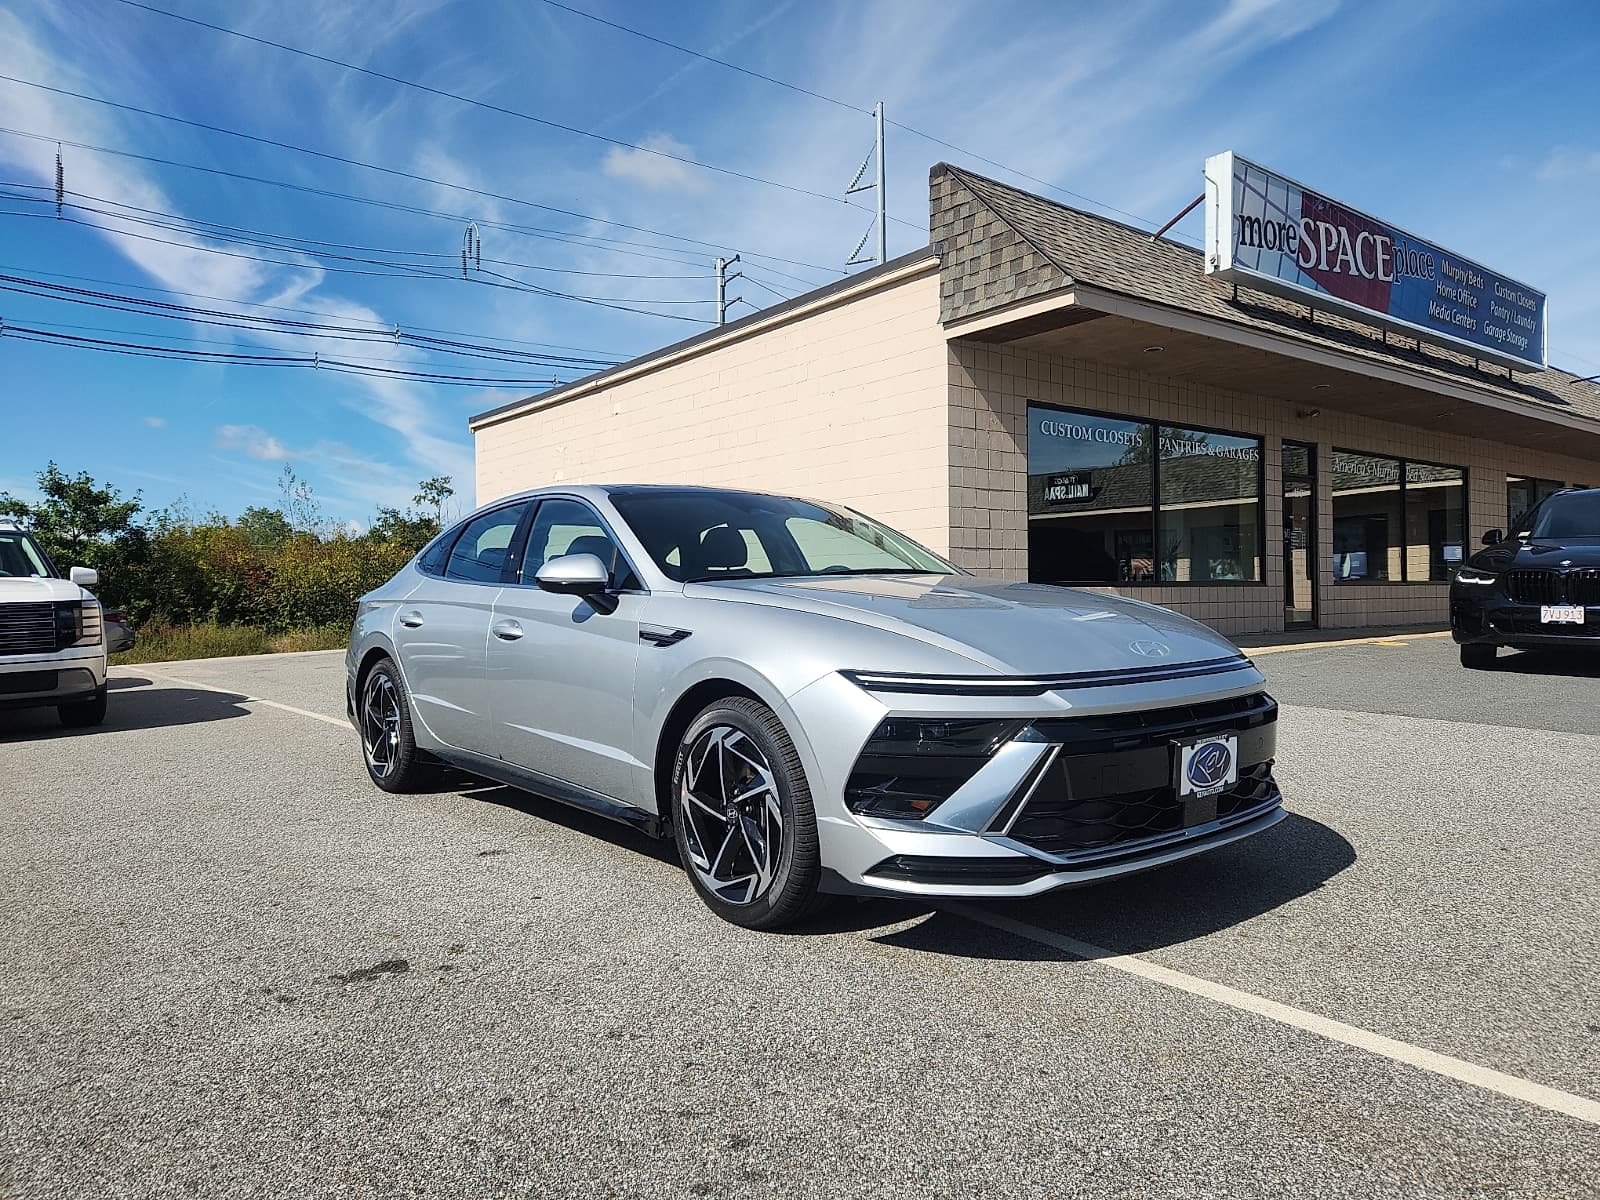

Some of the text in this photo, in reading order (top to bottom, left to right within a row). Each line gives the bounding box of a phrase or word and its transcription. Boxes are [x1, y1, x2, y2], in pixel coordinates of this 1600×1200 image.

[1441, 259, 1484, 289] Murphy Beds
[1436, 280, 1478, 308] Home Office
[1494, 282, 1536, 311] Custom Closets
[1428, 300, 1477, 330] Media Centers
[1490, 300, 1511, 324] Pantry
[1514, 311, 1537, 334] Laundry
[1483, 320, 1528, 351] Garage Storage
[1041, 420, 1143, 447] CUSTOM CLOSETS
[1159, 437, 1259, 461] PANTRIES & GARAGES
[1333, 458, 1371, 477] America's
